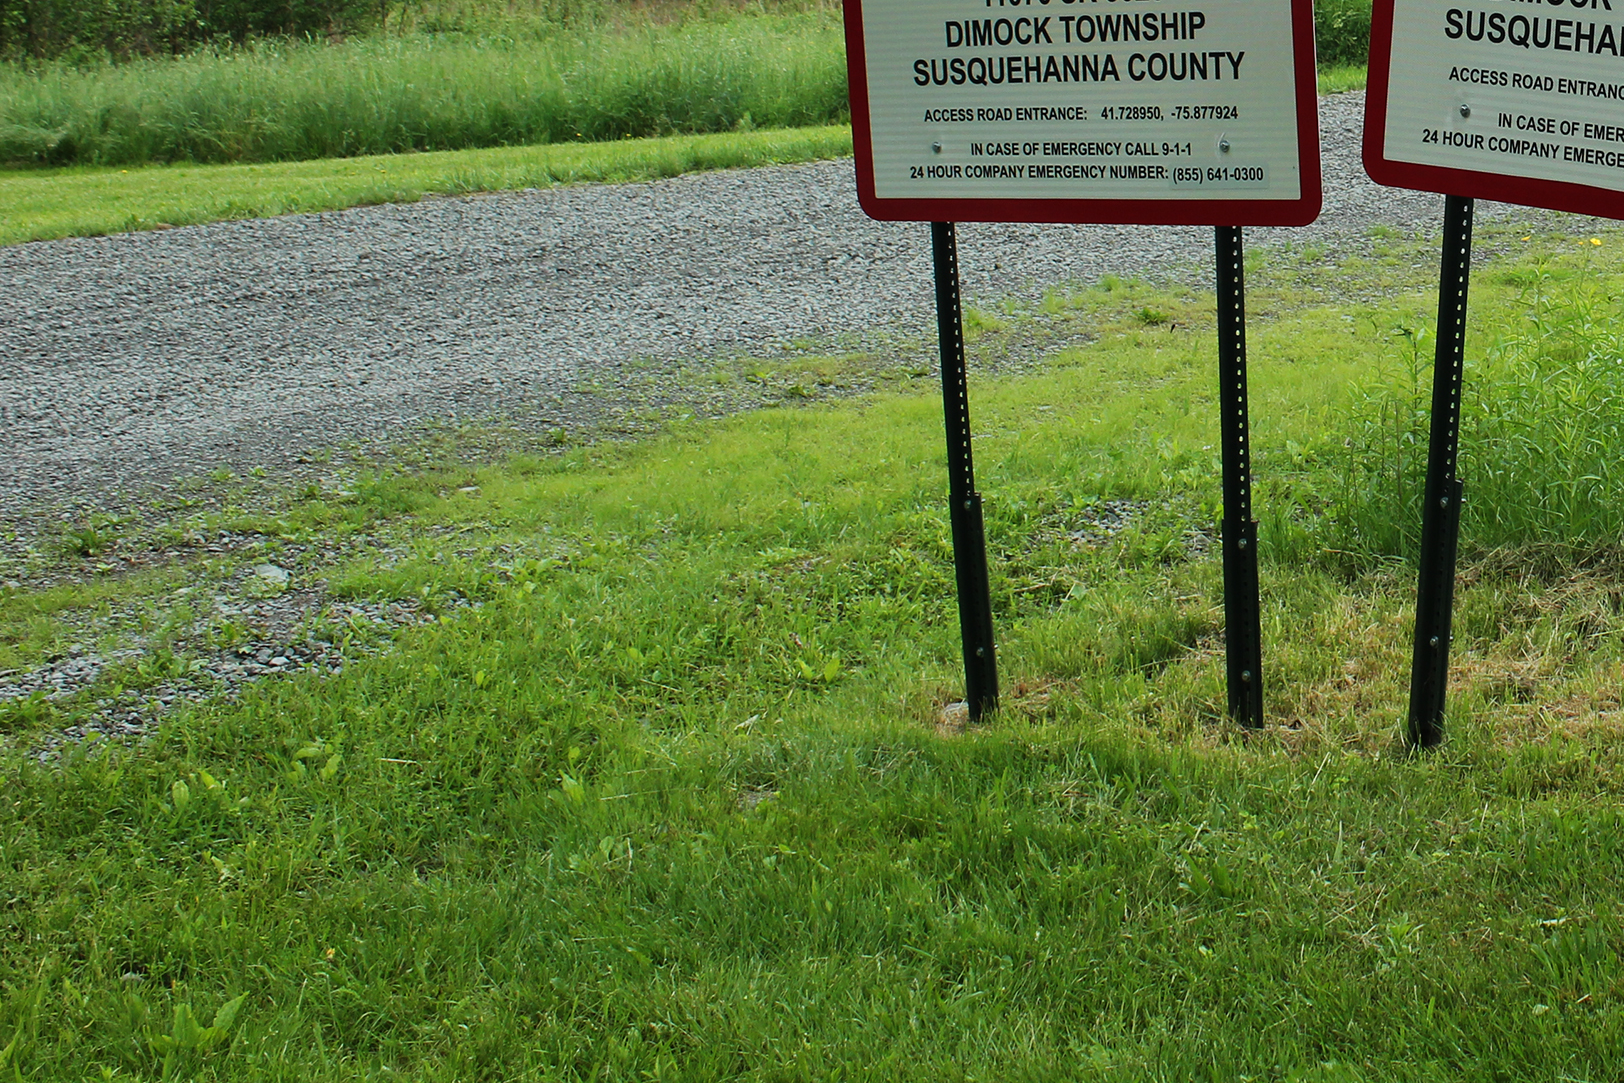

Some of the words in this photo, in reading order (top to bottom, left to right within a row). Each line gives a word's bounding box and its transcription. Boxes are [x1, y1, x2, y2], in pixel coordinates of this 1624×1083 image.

[945, 16, 1053, 48] DIMOCK
[1058, 11, 1206, 44] TOWNSHIP
[913, 53, 1121, 87] SUSQUEHANNA
[1127, 51, 1246, 82] COUNTY
[1448, 66, 1508, 87] ACCESS
[1511, 72, 1554, 92] ROAD
[923, 108, 974, 123] ACCESS
[976, 107, 1013, 122] ROAD
[1015, 106, 1088, 121] ENTRANCE:
[1100, 105, 1164, 122] 41.728950,
[1170, 105, 1239, 120] -75.877924
[1498, 112, 1513, 129] IN
[1516, 114, 1556, 134] CASE
[1559, 120, 1581, 137] OF
[970, 142, 983, 156] IN
[985, 142, 1020, 156] CASE
[1022, 142, 1040, 156] OF
[1042, 141, 1122, 156] EMERGENCY
[1124, 141, 1160, 156] CALL
[1161, 142, 1192, 156] 9-1-1
[1421, 128, 1439, 145] 24
[1442, 130, 1485, 150] HOUR
[1488, 136, 1560, 160] COMPANY
[909, 165, 925, 179] 24
[926, 165, 963, 179] HOUR
[964, 164, 1025, 179] COMPANY
[1027, 164, 1107, 179] EMERGENCY
[1109, 165, 1169, 180] NUMBER:
[1172, 167, 1204, 185] (855)
[1206, 166, 1264, 182] 641-0300
